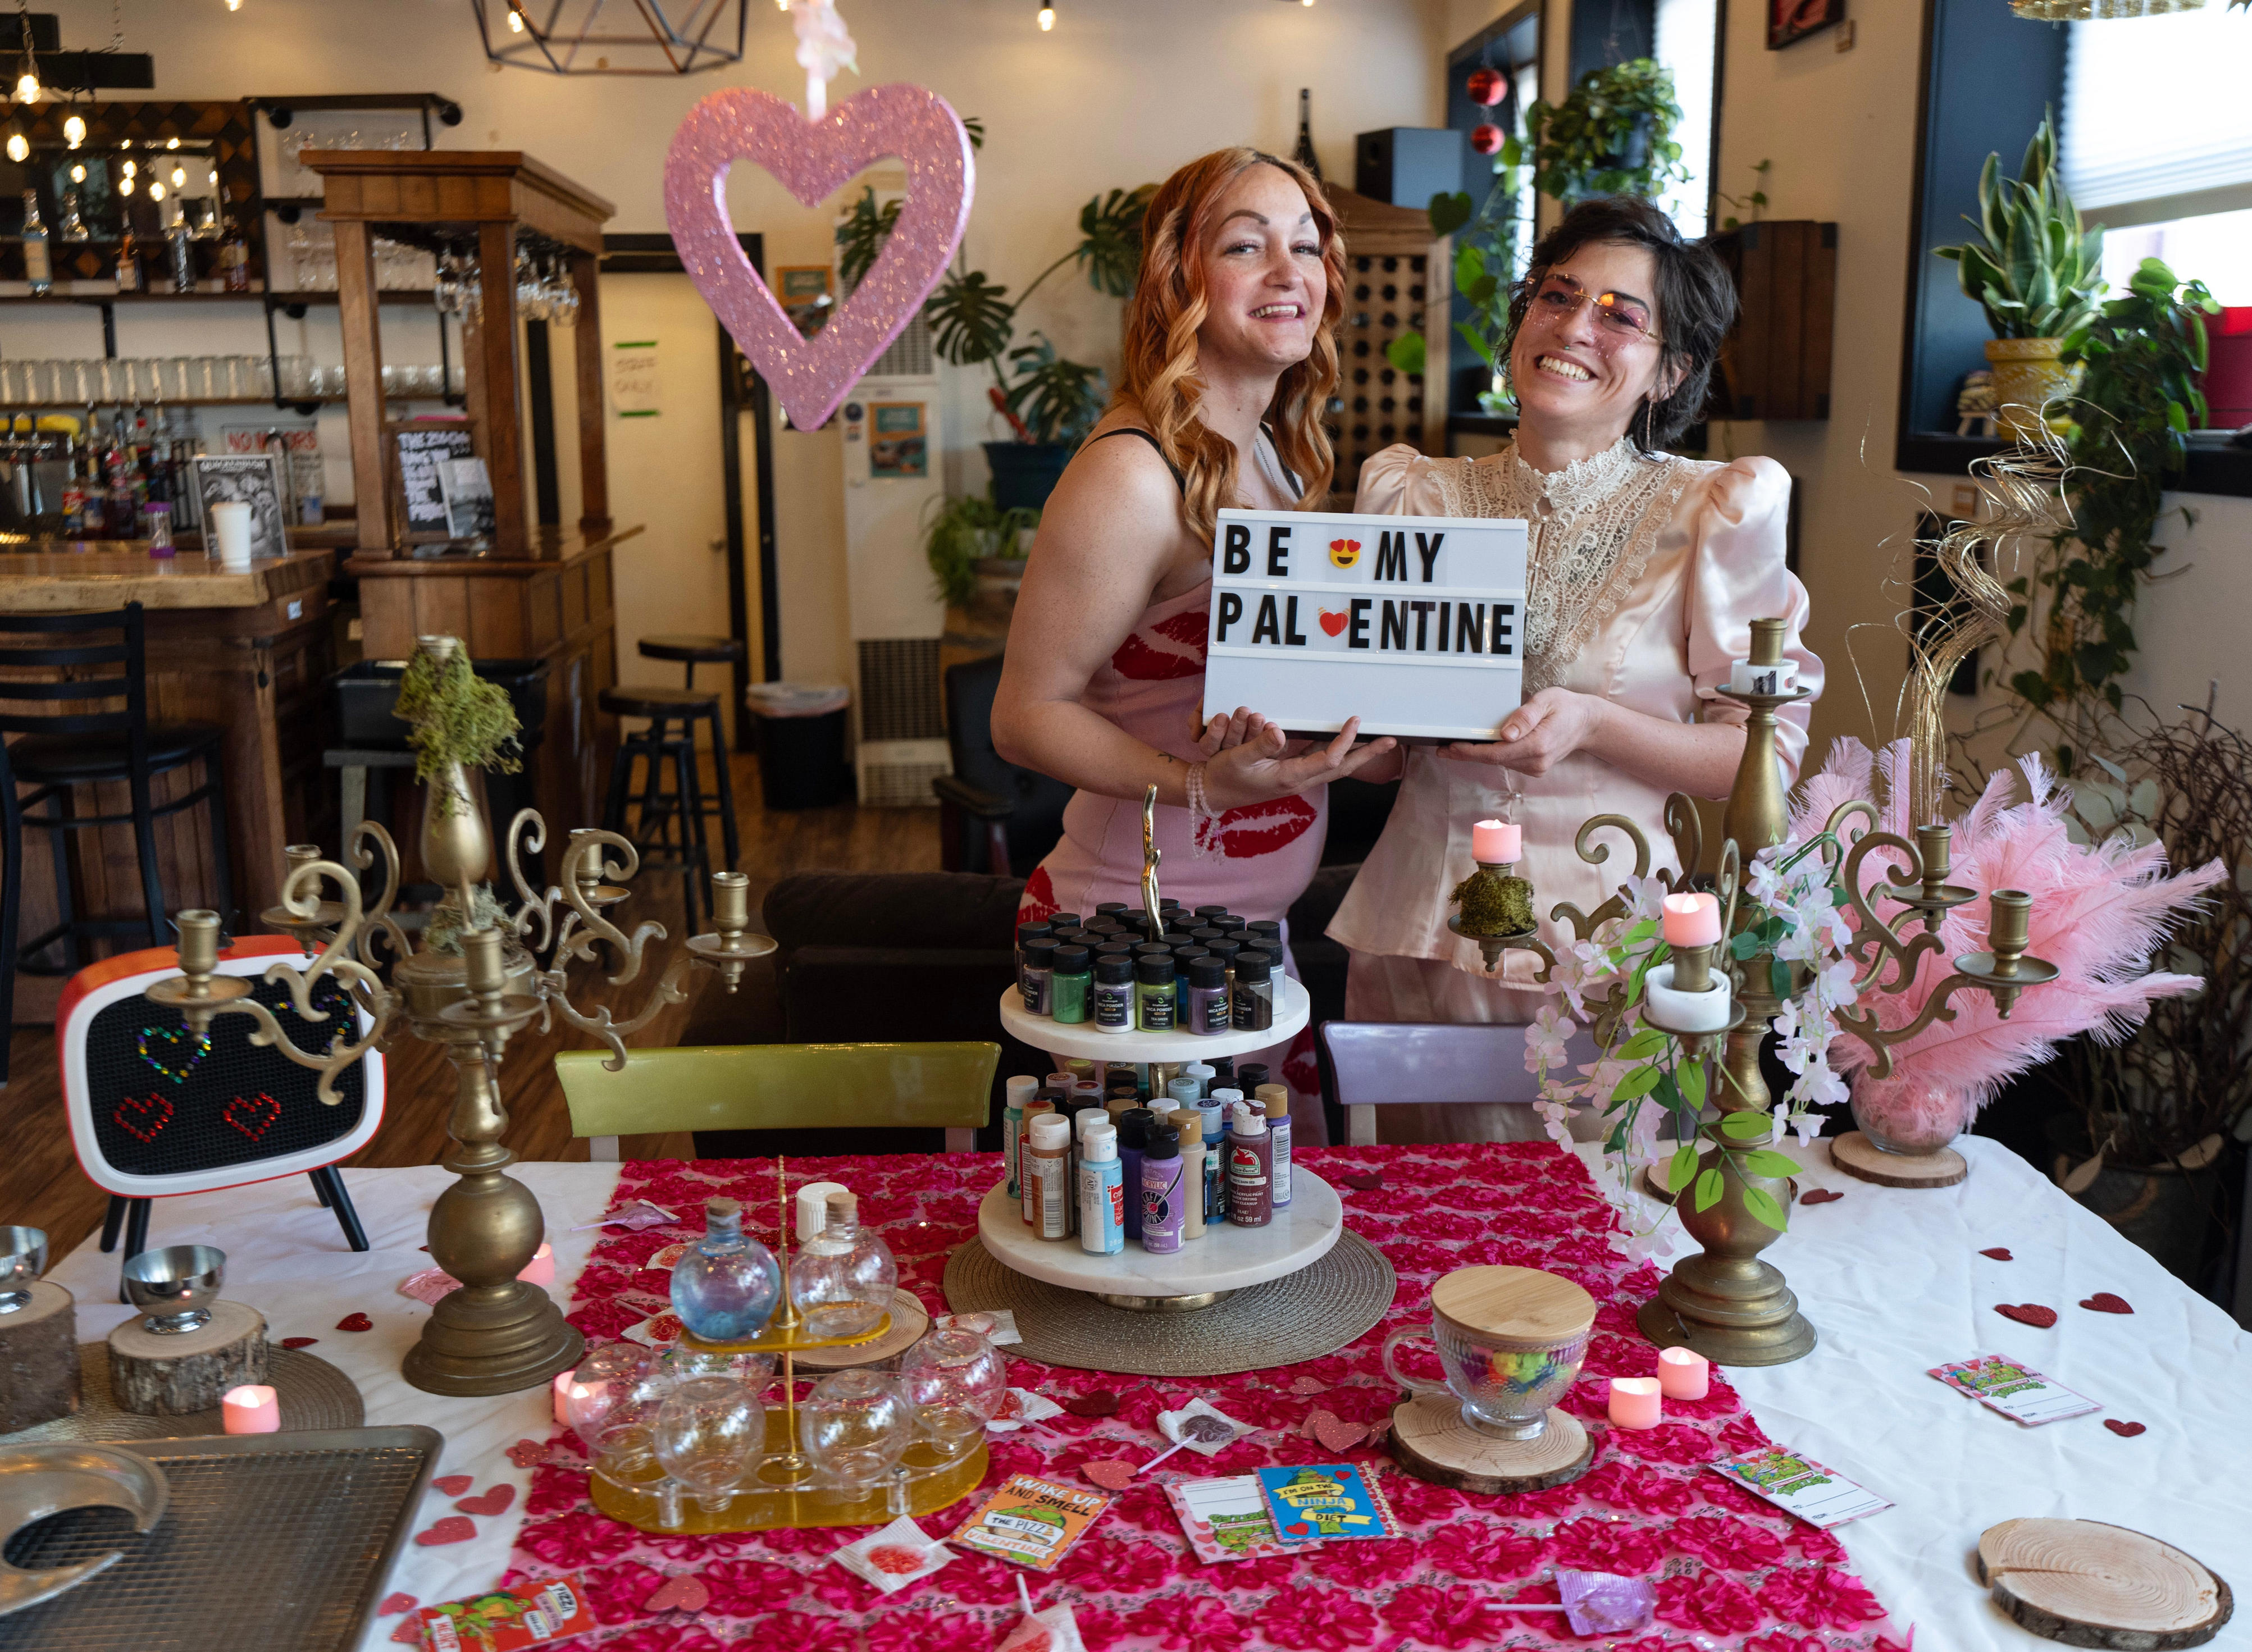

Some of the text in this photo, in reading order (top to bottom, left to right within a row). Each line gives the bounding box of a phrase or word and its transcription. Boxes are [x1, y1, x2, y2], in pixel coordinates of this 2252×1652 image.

[1223, 524, 1445, 583] BE MY
[1142, 1180, 1166, 1189] ACRYLIC
[1014, 1477, 1101, 1507] WAKE UP
[1005, 1486, 1090, 1516] AND SMELL
[1297, 1498, 1346, 1506] NINJA
[992, 1517, 1013, 1525] THE
[1315, 1513, 1347, 1522] DIET
[967, 1531, 1045, 1555] VALENTINE
